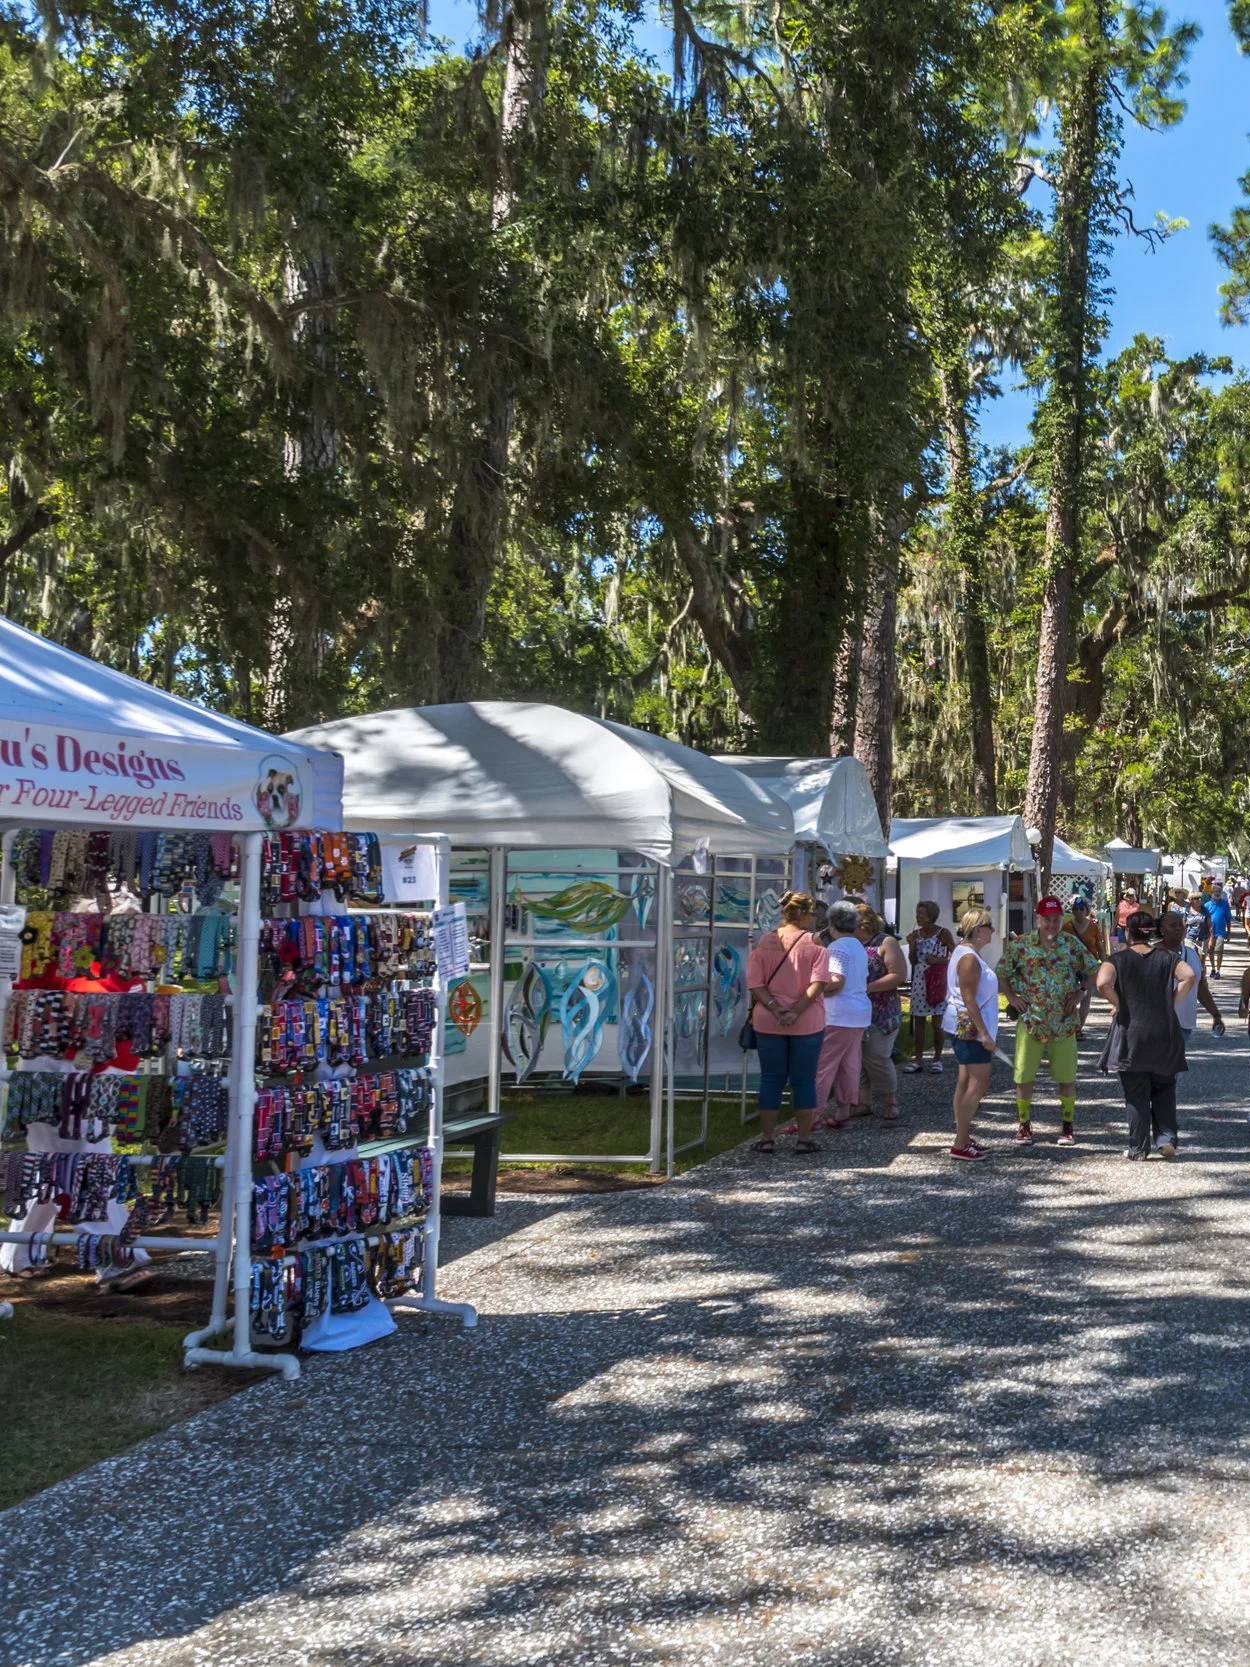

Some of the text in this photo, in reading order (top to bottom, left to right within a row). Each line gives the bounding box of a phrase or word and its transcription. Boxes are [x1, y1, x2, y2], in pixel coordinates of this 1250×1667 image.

[56, 734, 185, 789] Designs
[11, 778, 168, 821] Four-Legged
[167, 793, 244, 821] Friends
[402, 876, 417, 884] #23
